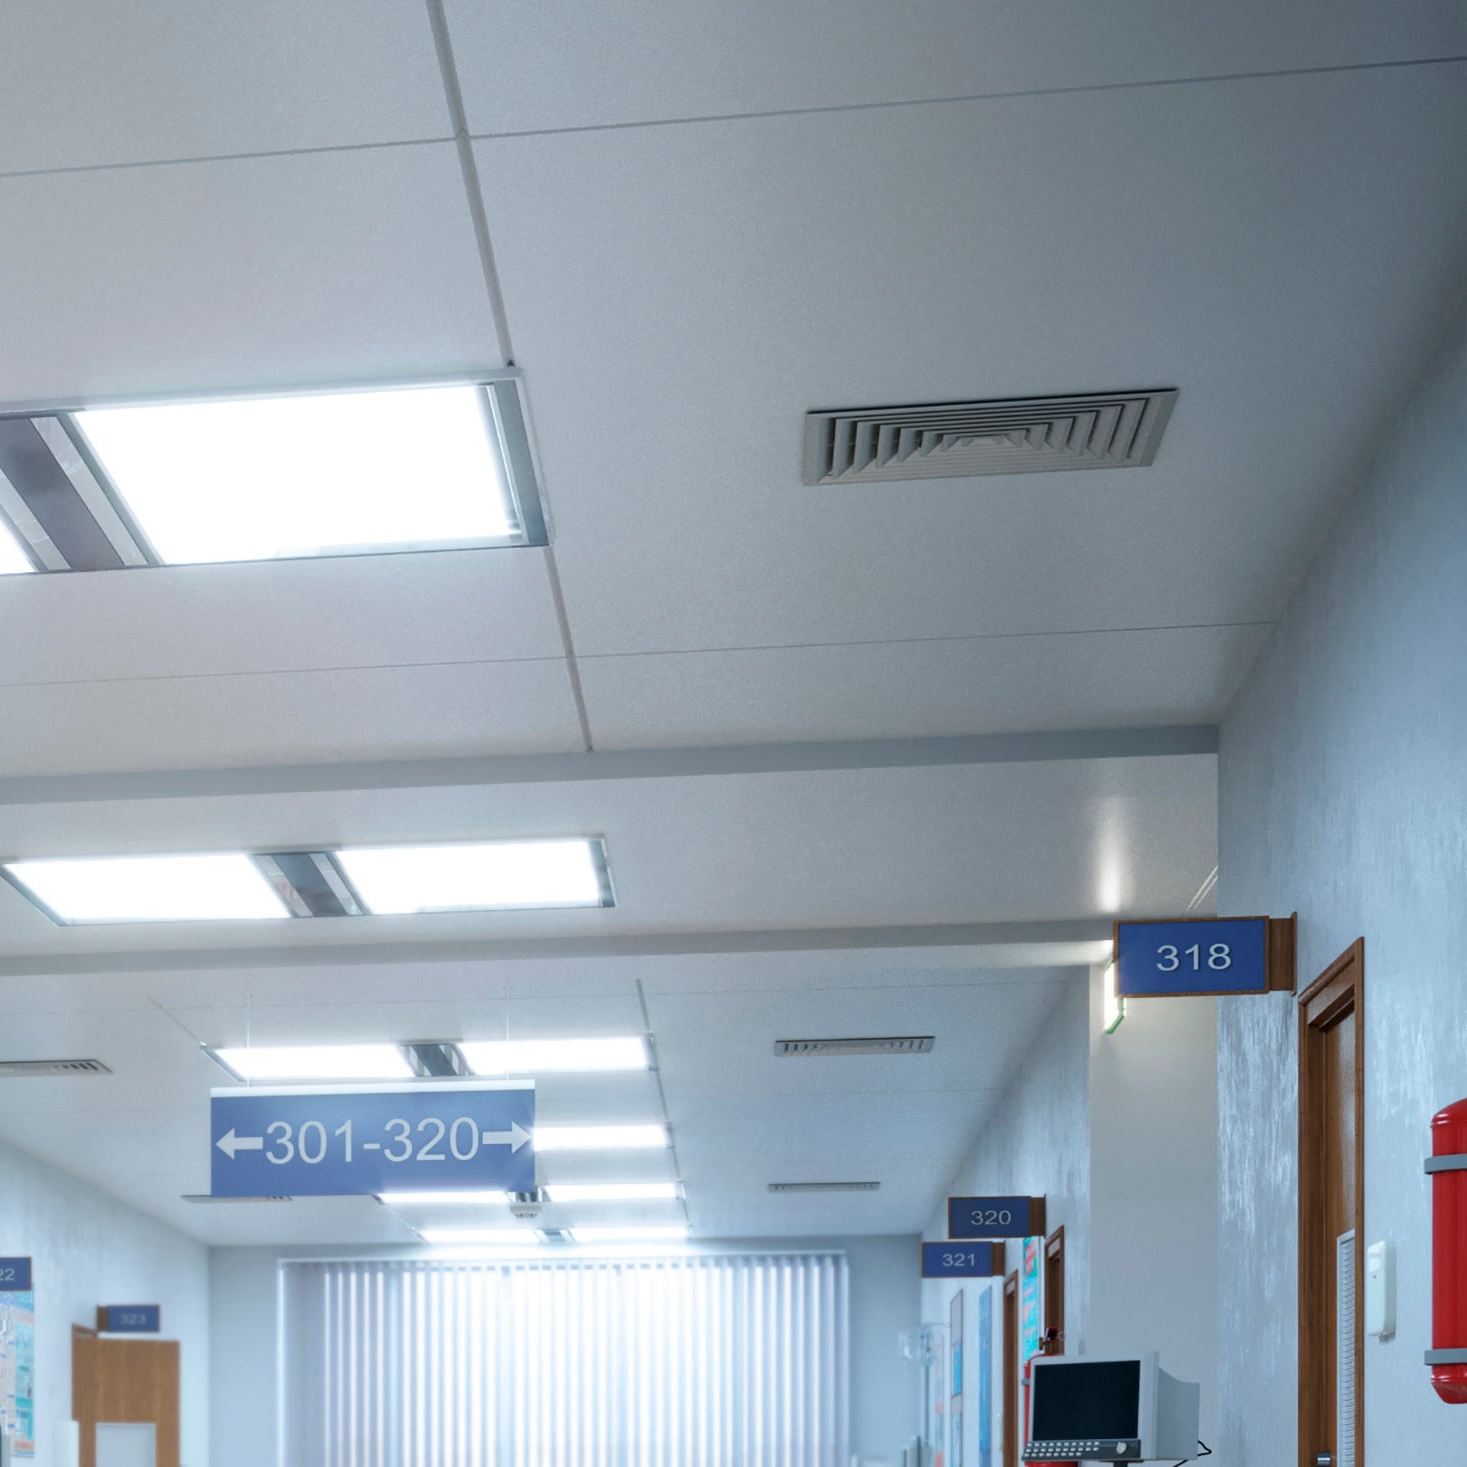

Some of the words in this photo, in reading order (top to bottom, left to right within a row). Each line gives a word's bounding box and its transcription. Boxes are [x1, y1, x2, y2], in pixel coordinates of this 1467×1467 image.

[1156, 943, 1231, 972] 318
[266, 1116, 479, 1165] 301-320
[970, 1209, 1012, 1225] 320
[942, 1252, 975, 1267] 321
